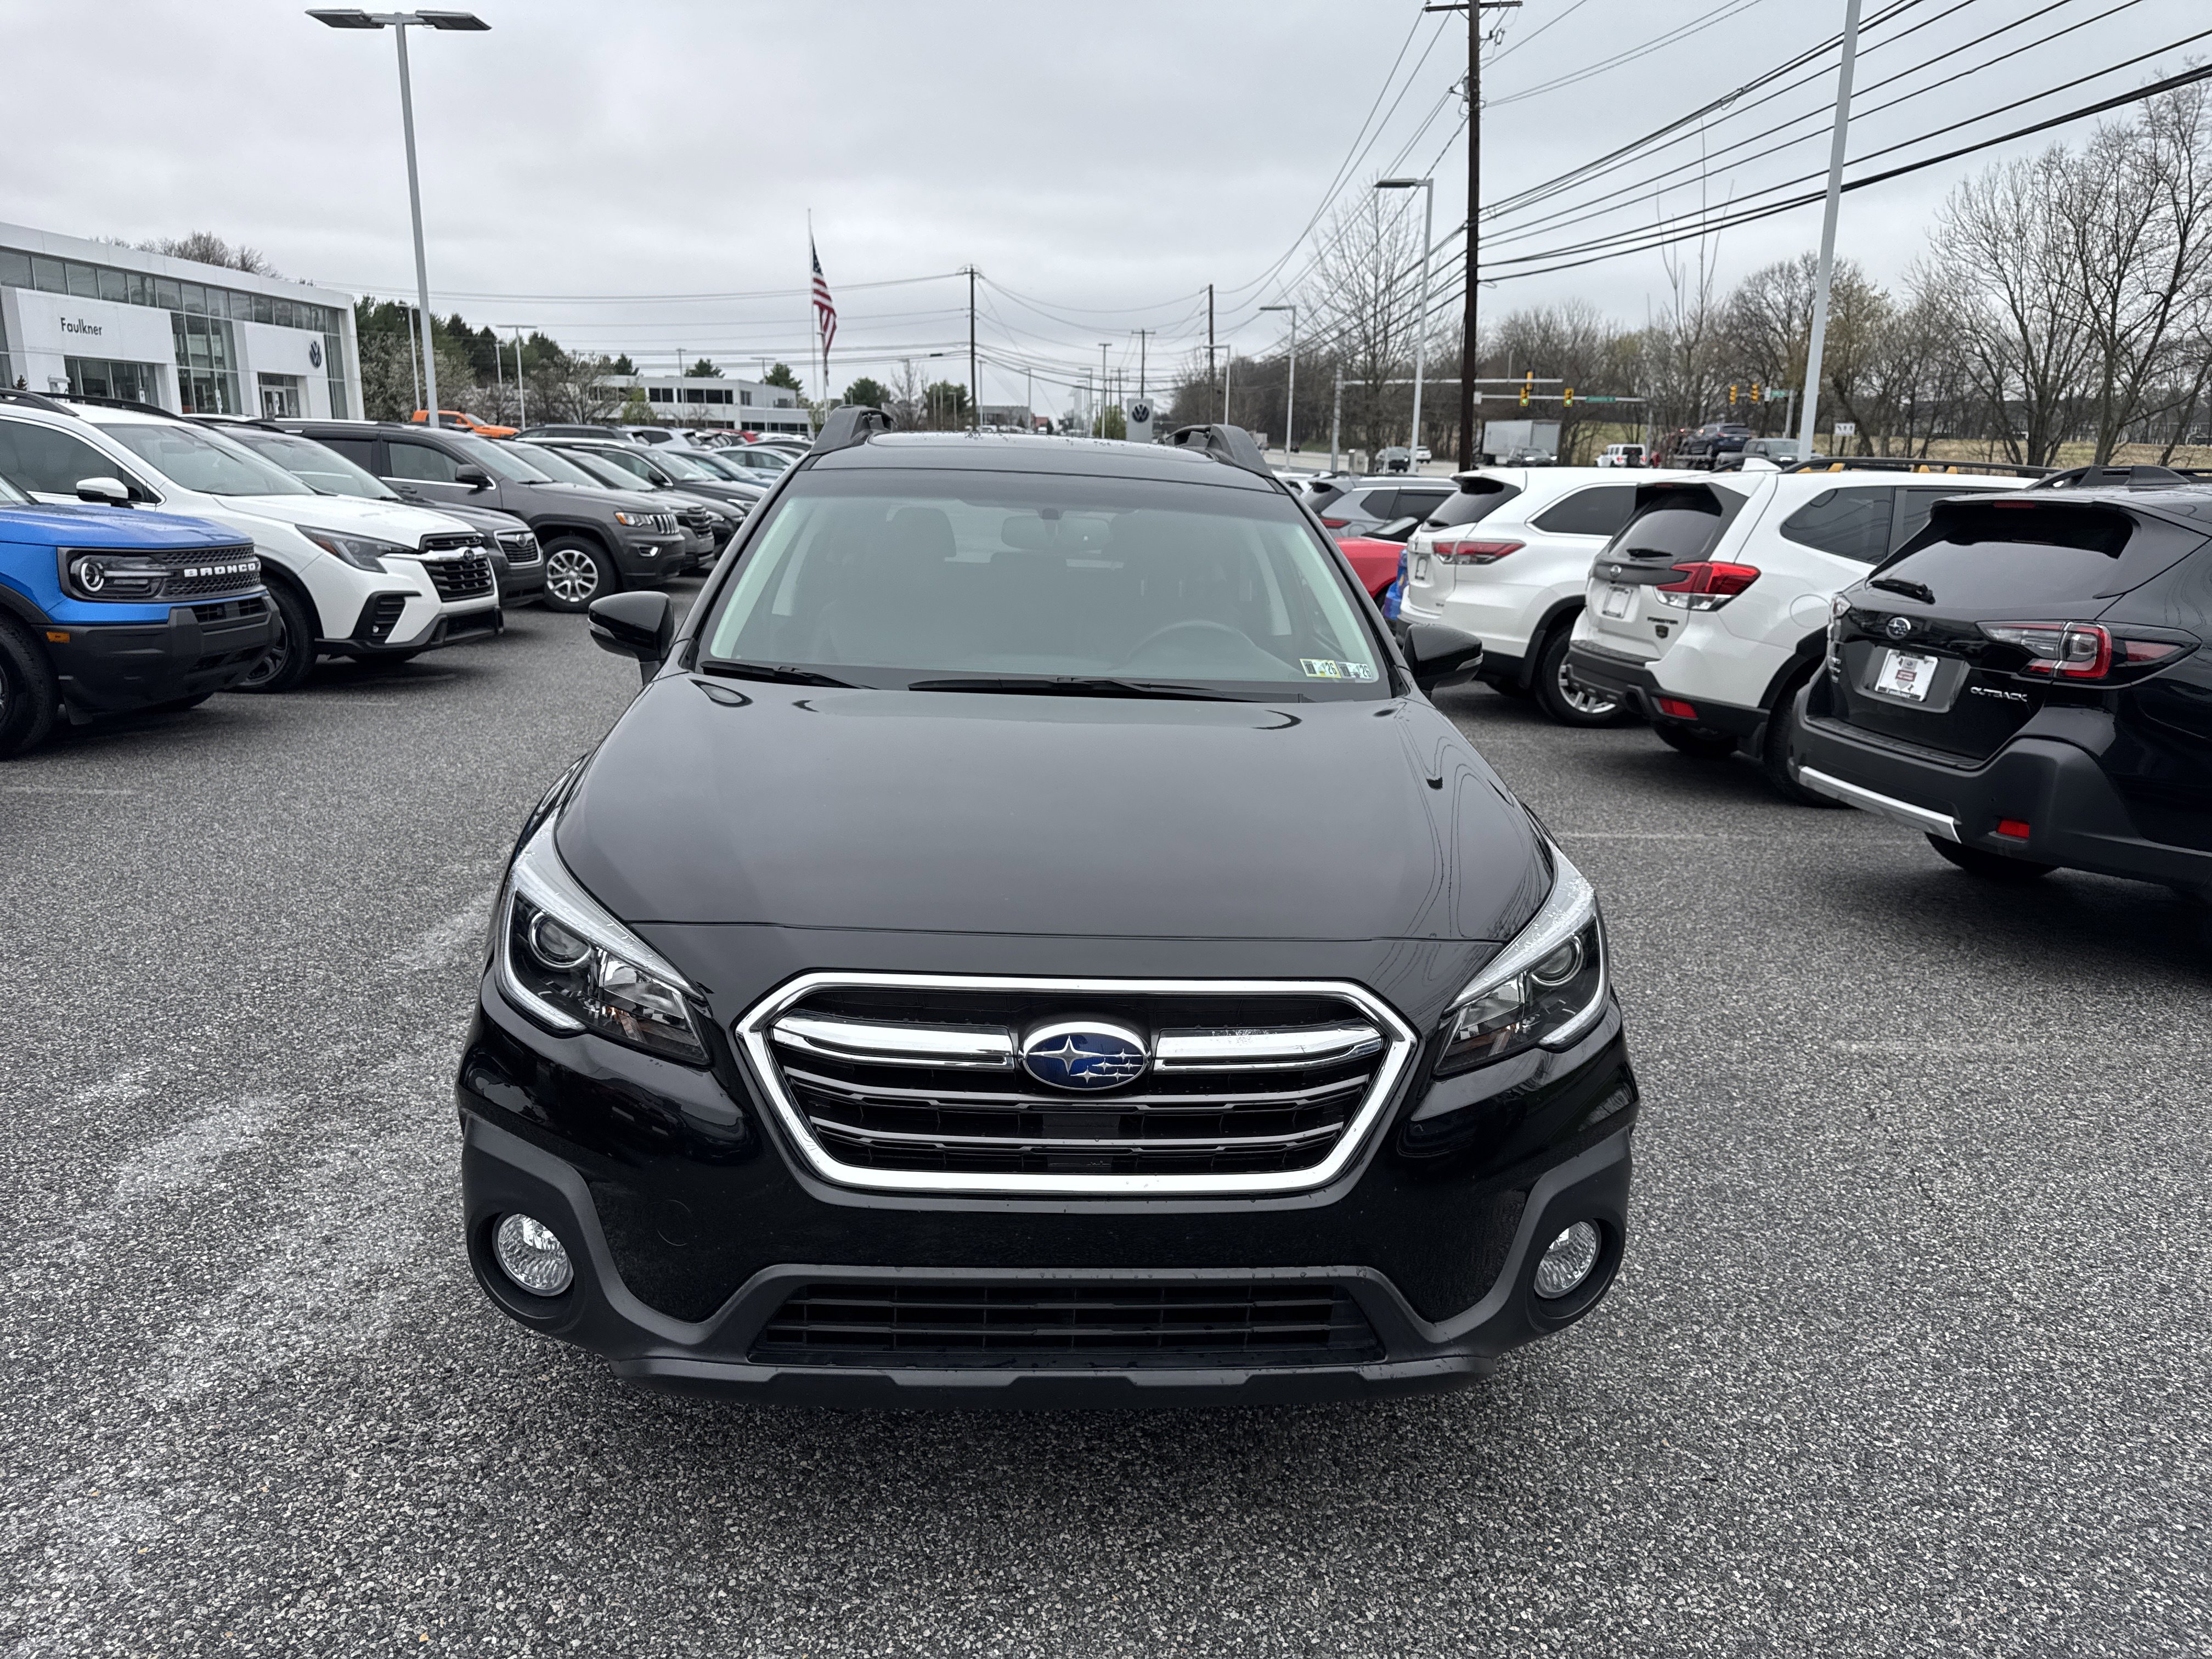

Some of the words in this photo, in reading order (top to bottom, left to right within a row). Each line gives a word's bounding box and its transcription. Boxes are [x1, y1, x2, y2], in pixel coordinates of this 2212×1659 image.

[60, 317, 102, 336] Faulkner
[184, 562, 256, 578] BRONCO
[1325, 662, 1337, 675] 26
[1359, 664, 1372, 678] 26
[1970, 686, 2028, 702] OUTBACK
